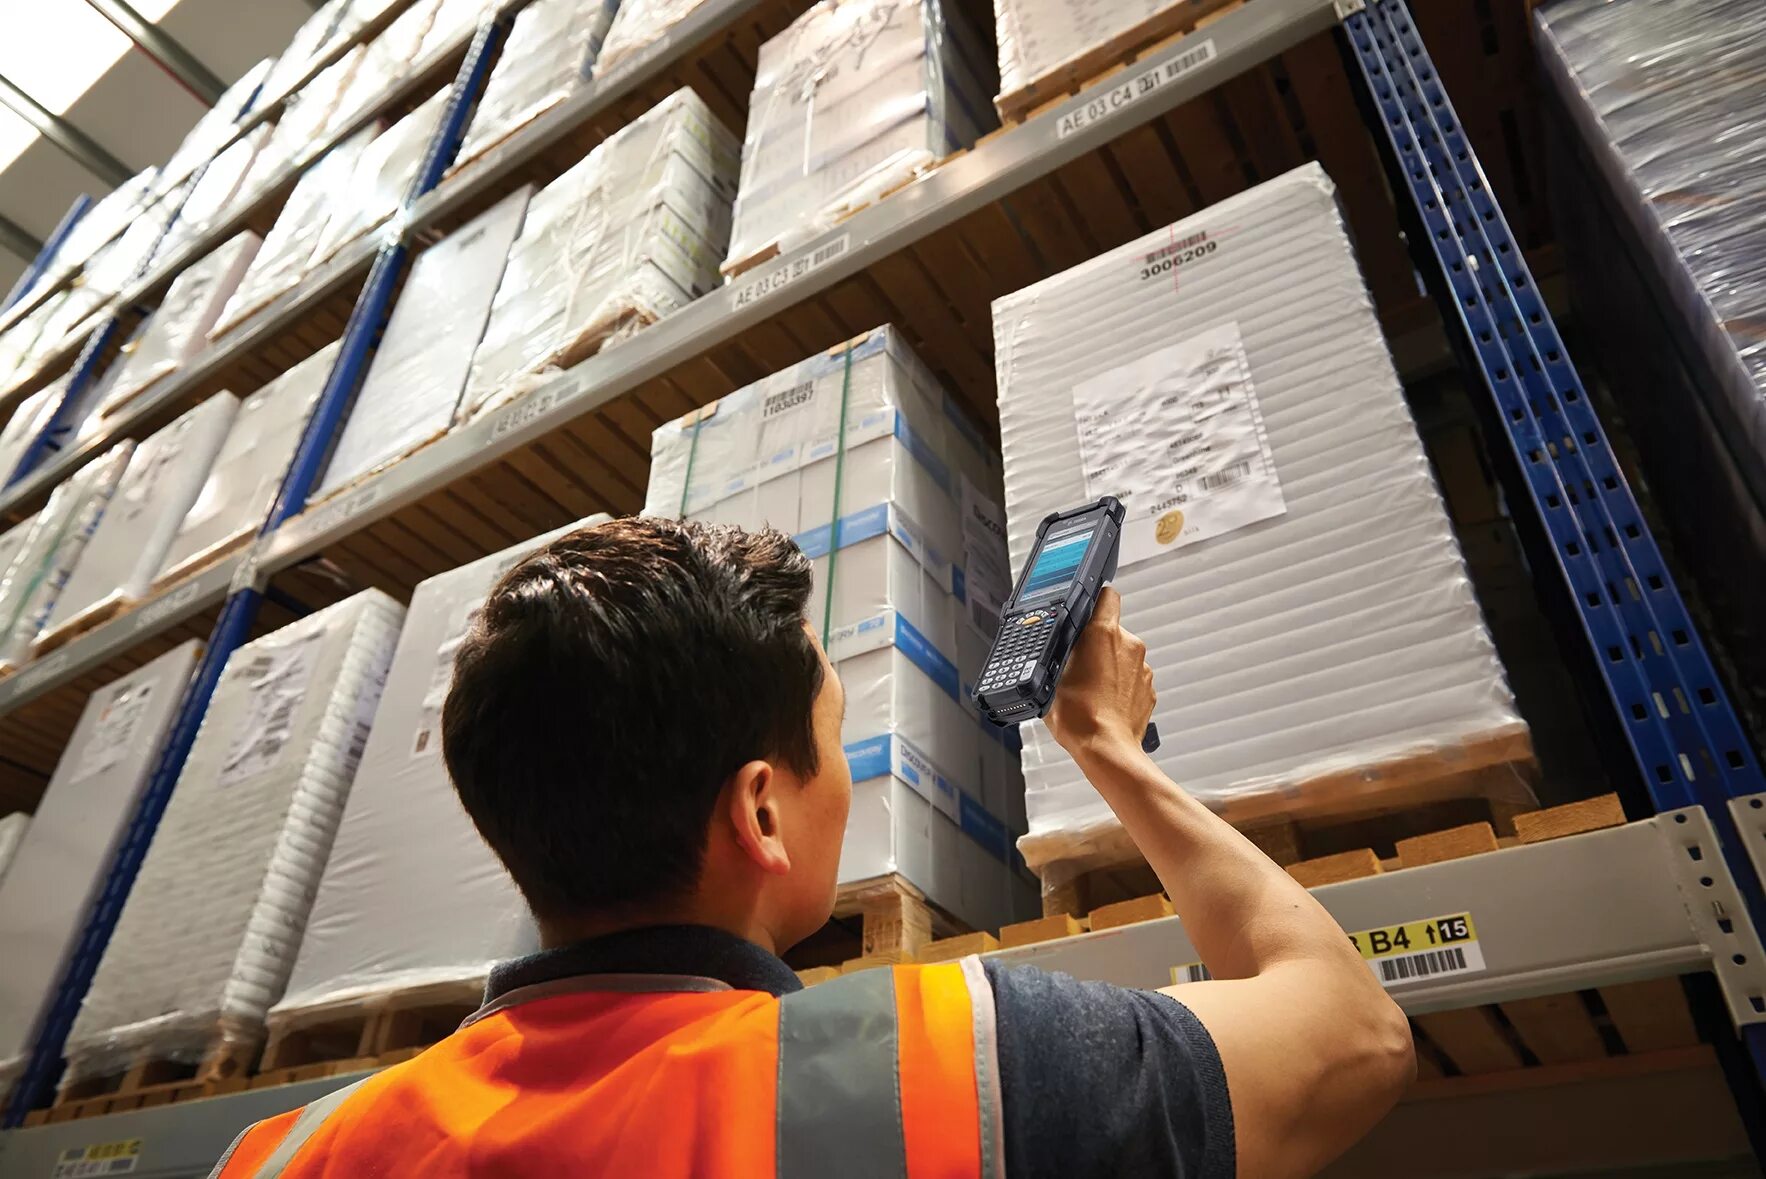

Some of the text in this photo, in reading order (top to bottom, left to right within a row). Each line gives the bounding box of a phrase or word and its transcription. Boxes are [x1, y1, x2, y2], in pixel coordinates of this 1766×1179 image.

[1062, 86, 1132, 133] AE 03 C4
[1140, 241, 1217, 280] 3006209
[1368, 926, 1411, 955] B4
[1440, 920, 1467, 939] 15
